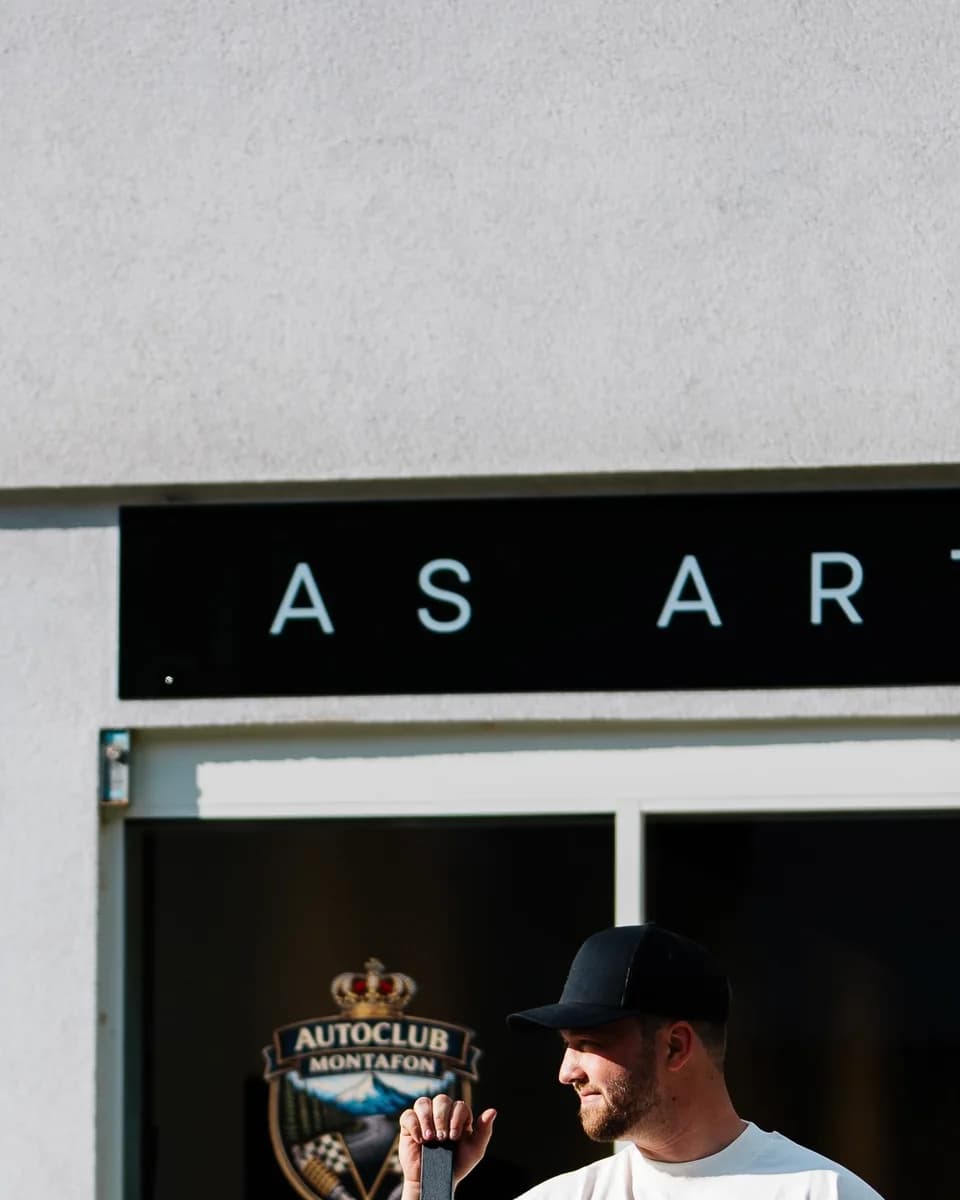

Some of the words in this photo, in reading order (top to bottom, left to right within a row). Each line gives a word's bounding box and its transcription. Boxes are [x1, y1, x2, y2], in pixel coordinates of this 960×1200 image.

[269, 556, 474, 636] AS
[294, 1022, 449, 1052] AUTOCLUB
[309, 1053, 436, 1073] MONTAFON
